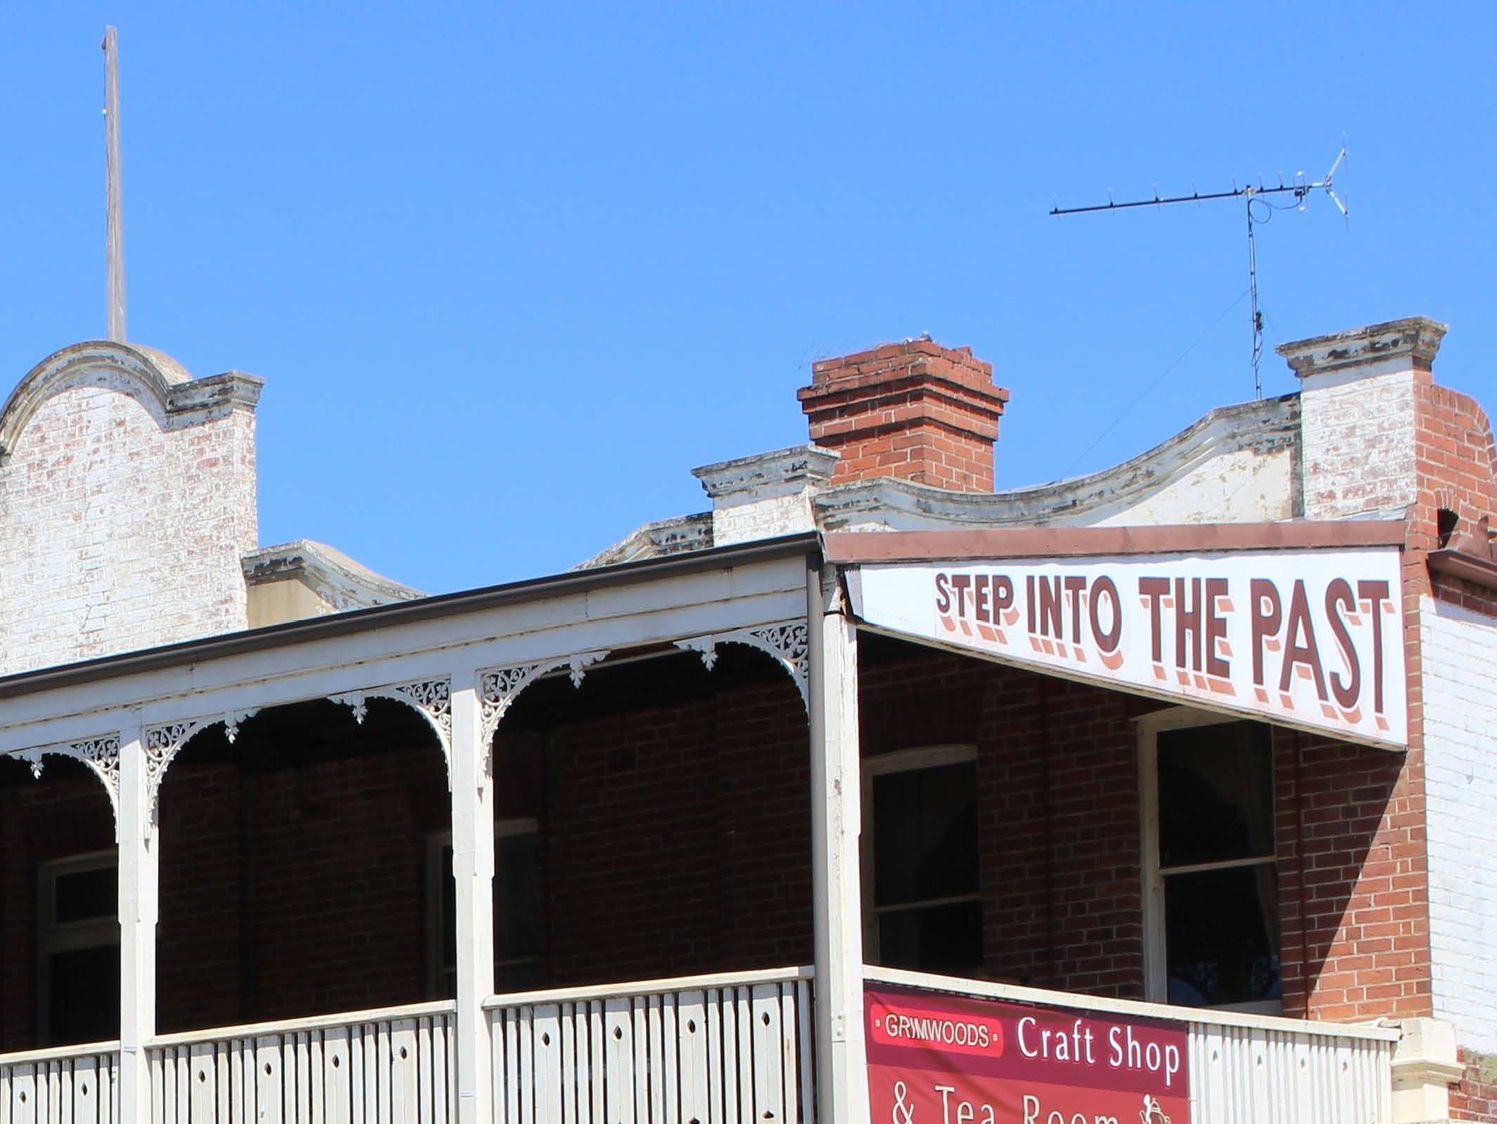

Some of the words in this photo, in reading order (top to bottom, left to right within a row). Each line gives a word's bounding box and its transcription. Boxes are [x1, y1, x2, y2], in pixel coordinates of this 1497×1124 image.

[935, 573, 1016, 632] STEP
[1026, 575, 1123, 662] INTO
[1138, 577, 1233, 688] THE
[1250, 577, 1392, 724] PAST
[885, 1013, 990, 1047] GRIMWOODS
[1017, 1016, 1095, 1064] Craft
[1109, 1026, 1180, 1087] Shop
